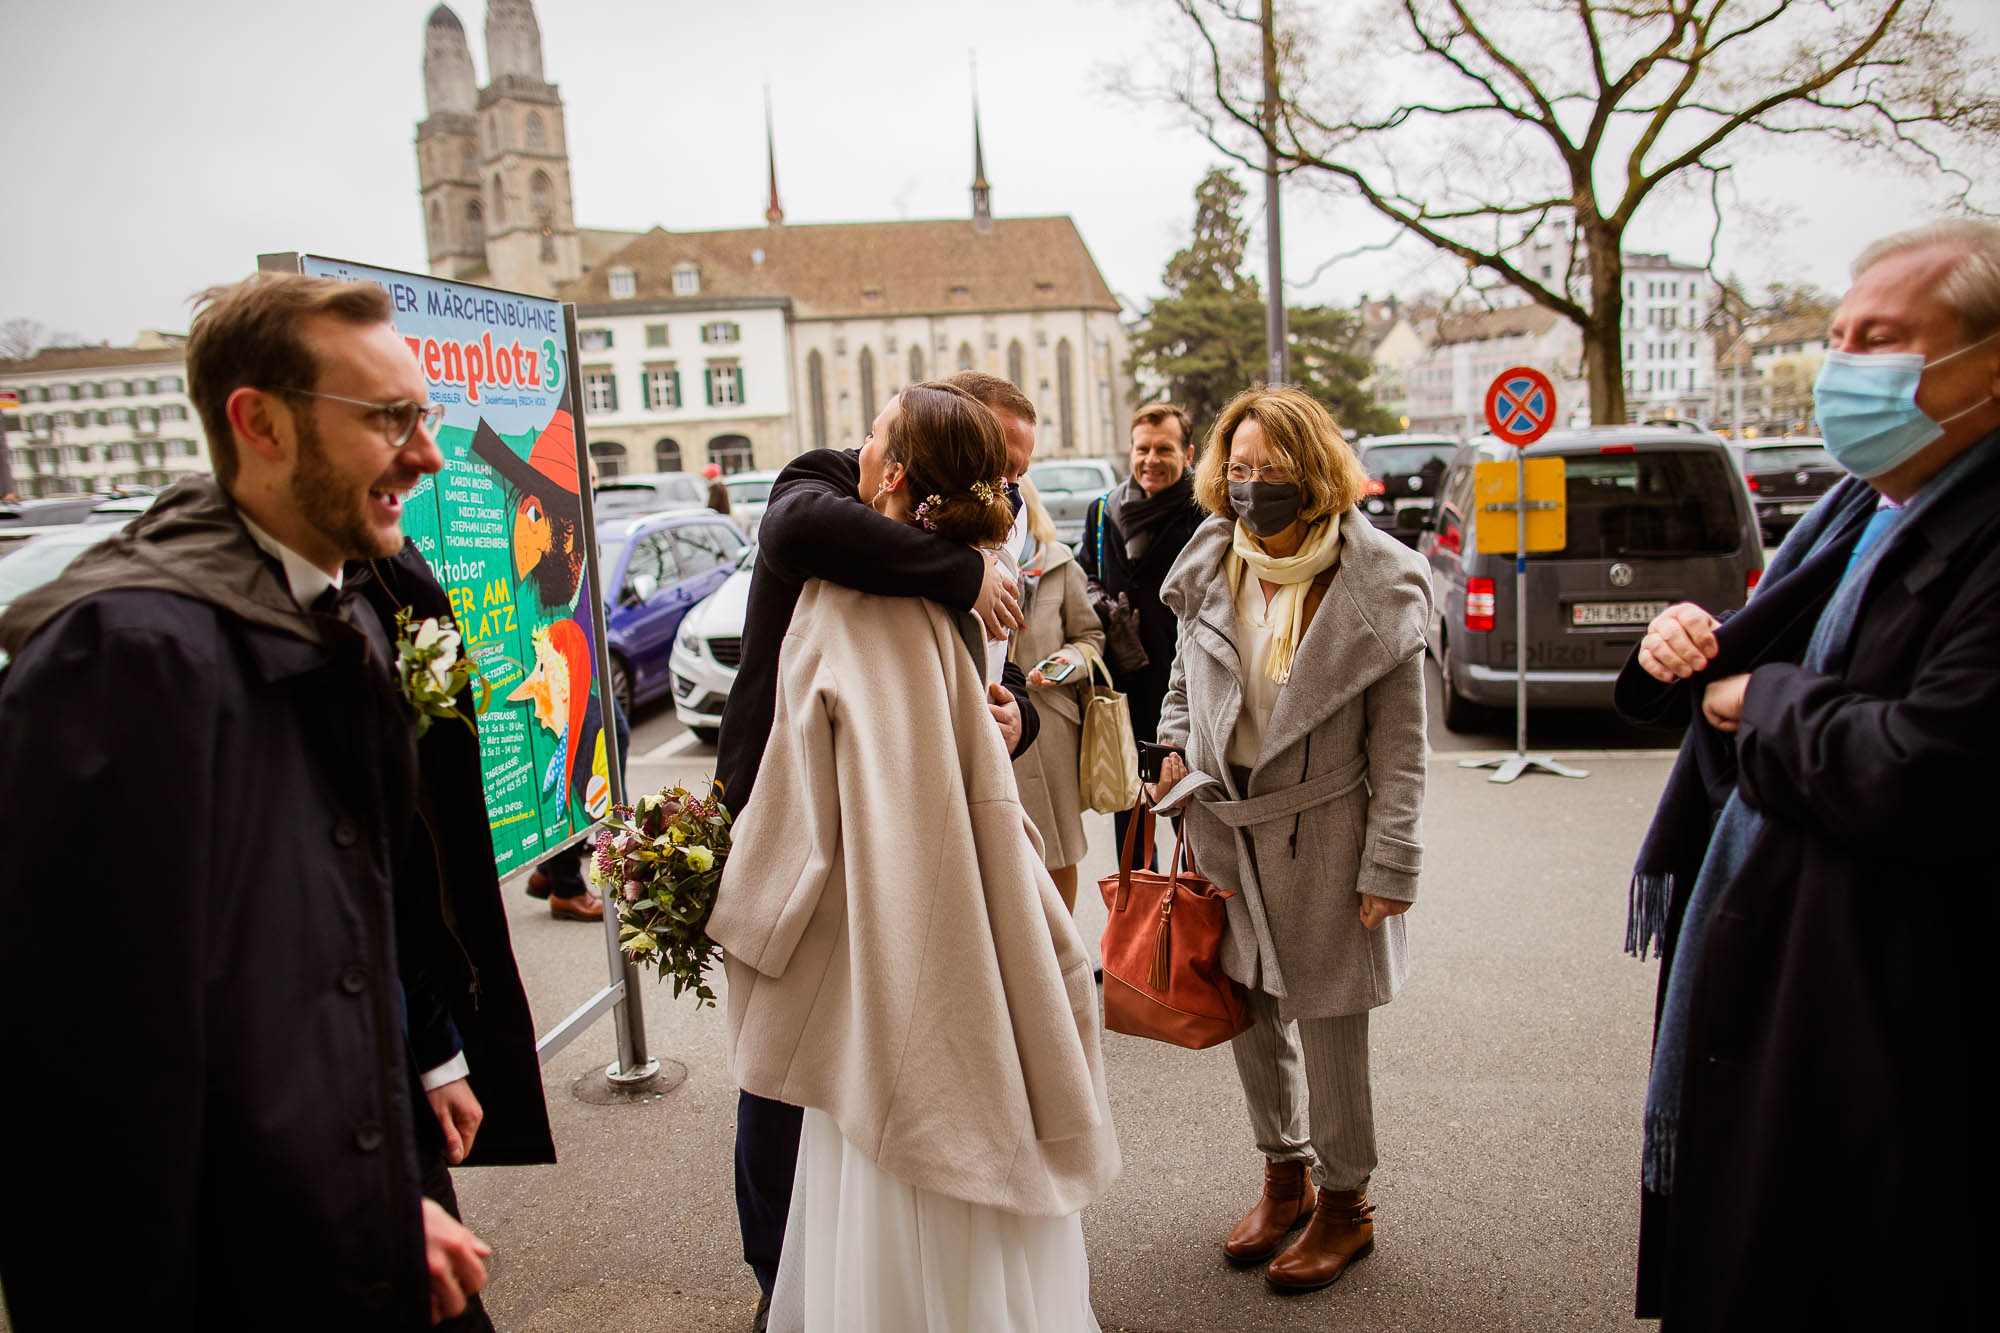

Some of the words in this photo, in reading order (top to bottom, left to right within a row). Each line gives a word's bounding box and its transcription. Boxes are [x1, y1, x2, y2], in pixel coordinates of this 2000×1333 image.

[427, 287, 557, 333] MÄRCHENBÜHNE
[543, 338, 560, 388] 3
[450, 475, 471, 487] KARIN
[445, 490, 469, 503] DANIEL
[450, 520, 479, 533] STEPHAN
[445, 535, 474, 548] THOMAS
[483, 577, 510, 608] AM
